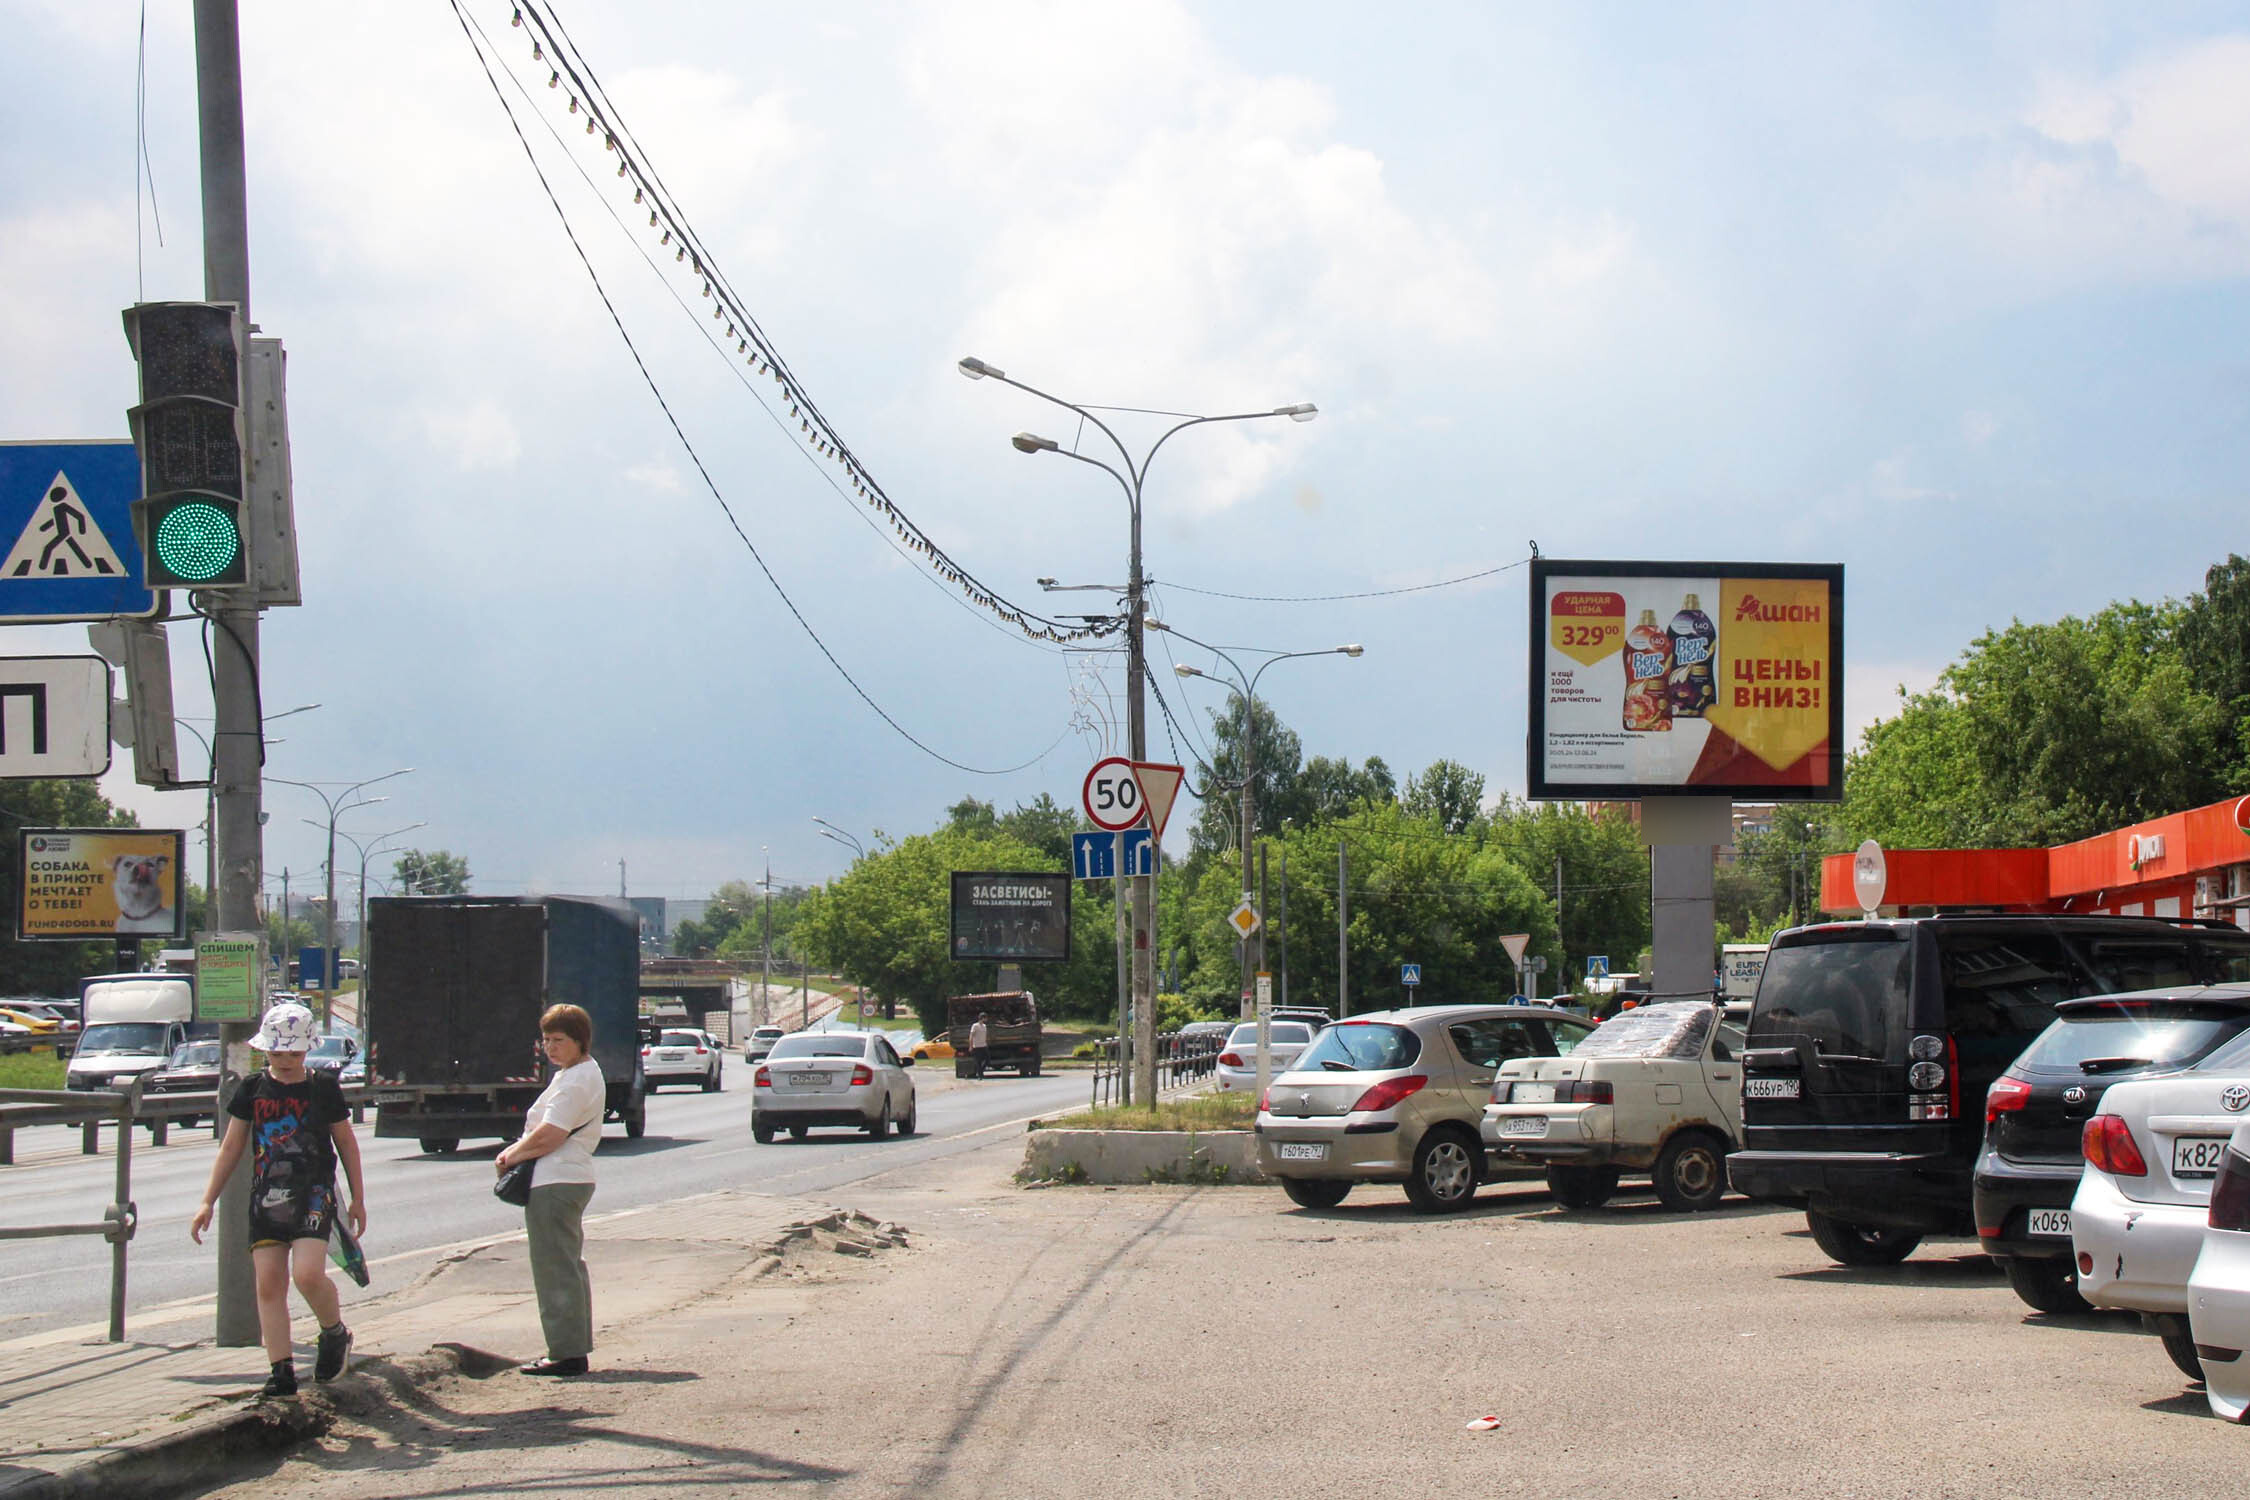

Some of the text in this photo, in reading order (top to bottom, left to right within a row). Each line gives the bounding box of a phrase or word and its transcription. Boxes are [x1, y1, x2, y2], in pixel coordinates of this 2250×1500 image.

[1564, 595, 1611, 605] УДАРНАЯ
[1575, 606, 1602, 615] ЦЕНА
[1562, 625, 1604, 646] 329
[1735, 660, 1820, 683] ЦЕНЫ
[1551, 678, 1572, 686] 1000
[1735, 687, 1820, 708] ВНИЗ!
[1097, 778, 1136, 809] 50
[30, 861, 90, 871] СОБАКА
[31, 874, 104, 884] В ПРИЮТЕ
[31, 887, 92, 896] МЕЧТАЕТ
[29, 899, 82, 909] О ТЕБЕ!
[201, 944, 254, 952] спишем
[2065, 1091, 2081, 1100] KIA
